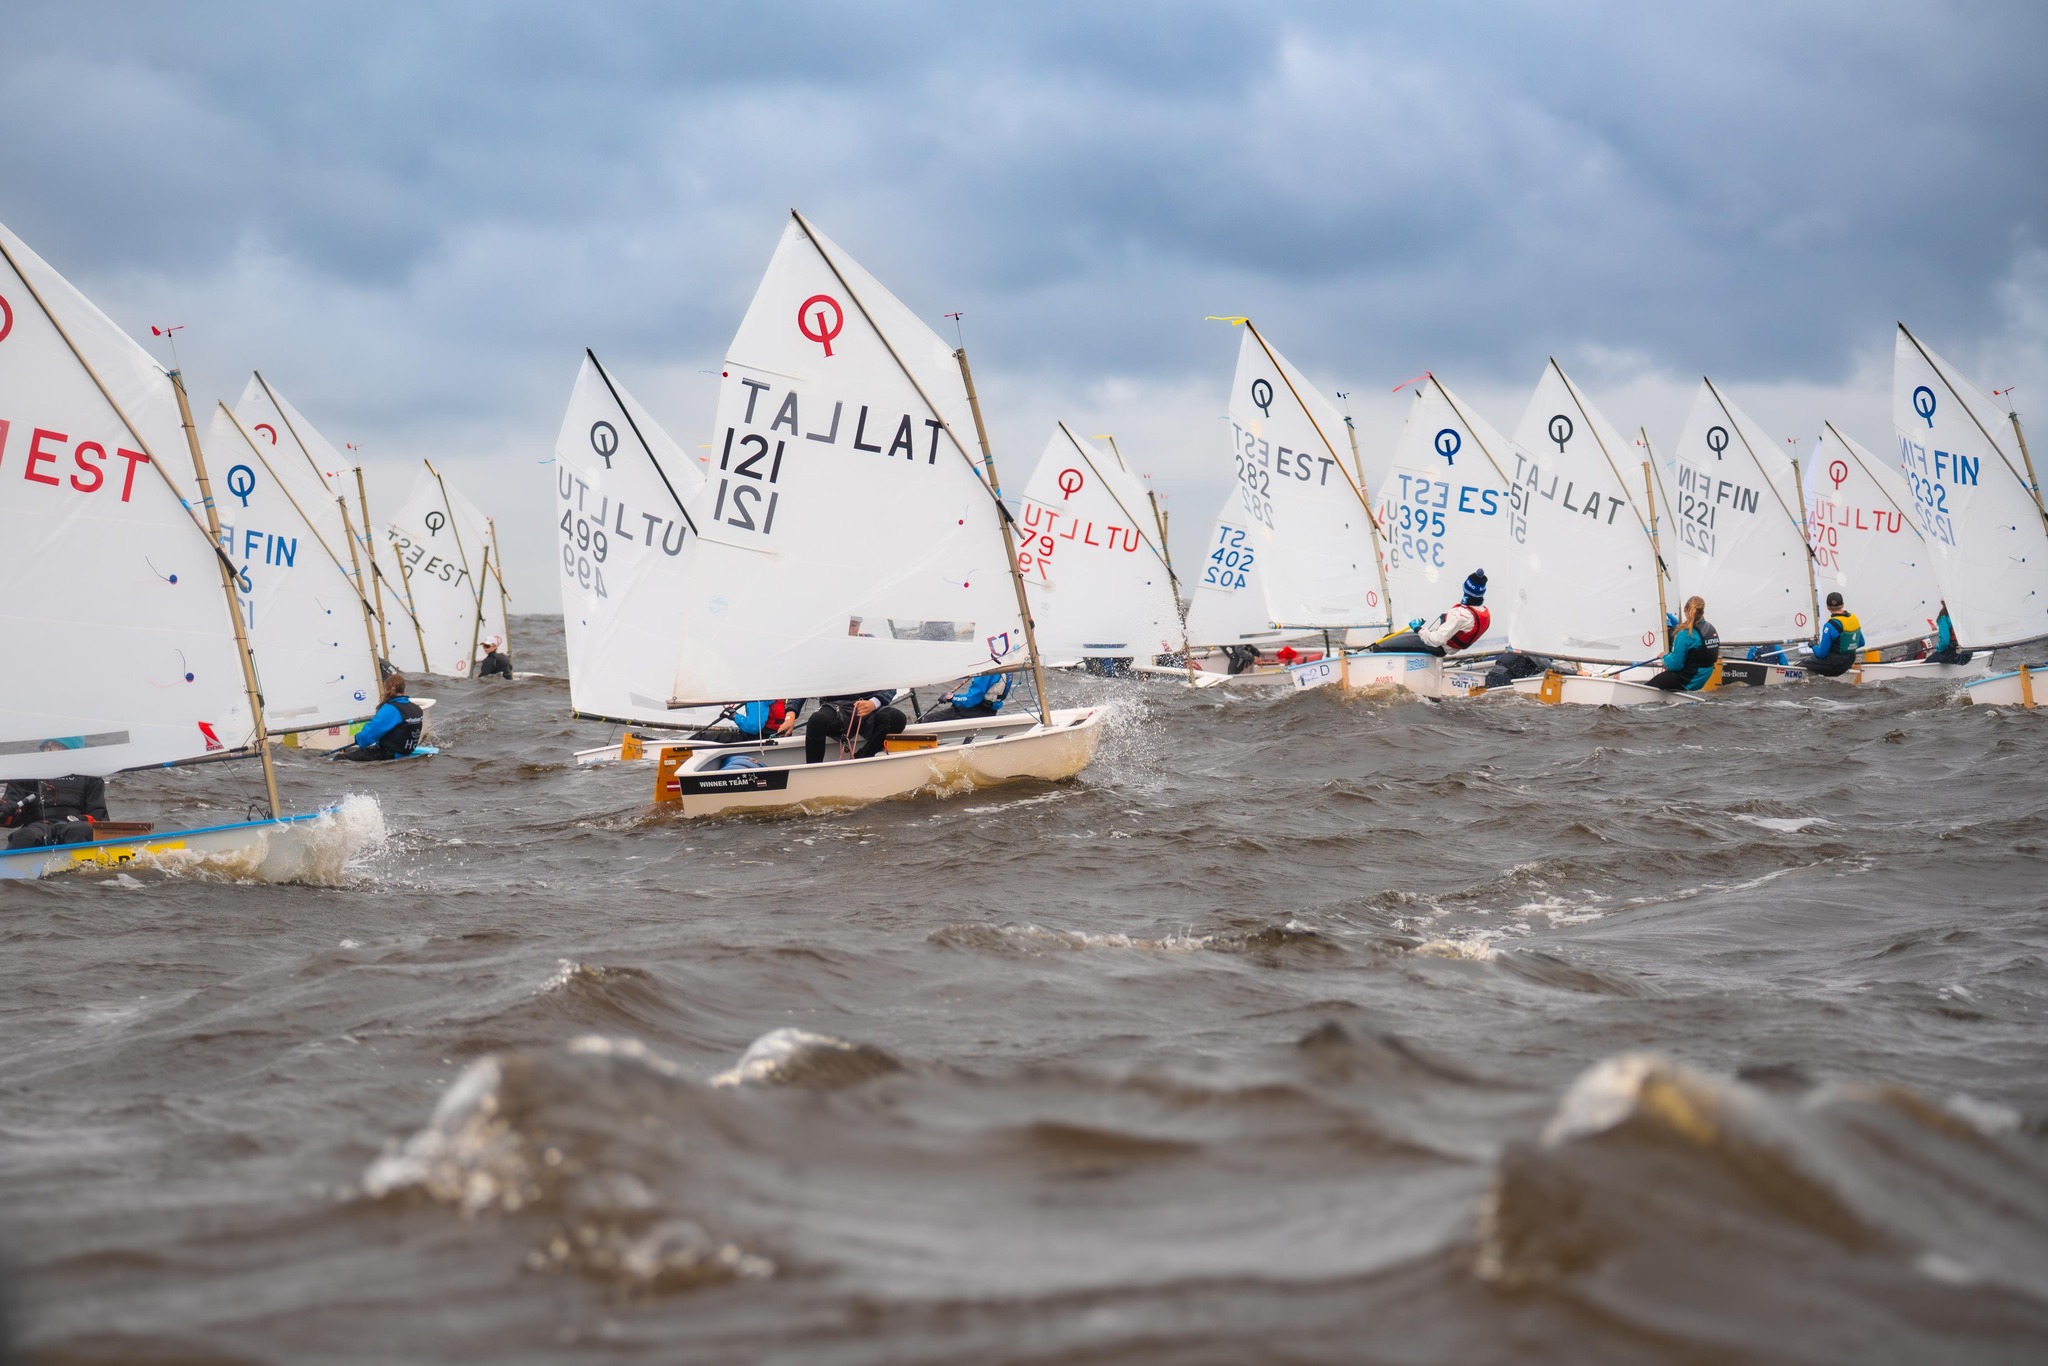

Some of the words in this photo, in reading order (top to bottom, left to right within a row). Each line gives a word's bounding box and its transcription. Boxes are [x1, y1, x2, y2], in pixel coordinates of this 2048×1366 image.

[854, 405, 949, 465] LAT
[24, 427, 150, 503] EST
[720, 427, 785, 484] 121
[1277, 446, 1335, 486] EST
[1934, 450, 1979, 486] FIN
[1235, 454, 1271, 499] 282
[1905, 468, 1949, 514] 1232
[1510, 482, 1529, 516] 51
[1562, 481, 1626, 525] LAT
[1678, 491, 1715, 530] 1221
[1717, 480, 1759, 514] FIN
[560, 508, 608, 563] 499
[615, 502, 686, 556] LTU
[1084, 522, 1140, 552] LTU
[1400, 505, 1446, 537] 395
[1817, 523, 1837, 547] 70
[1856, 508, 1901, 533] LTU
[245, 529, 297, 567] FIN
[1021, 527, 1055, 556] 79
[424, 556, 468, 587] EST
[1211, 548, 1254, 572] 402
[1784, 670, 1803, 679] NEMO
[699, 780, 728, 788] WINNER
